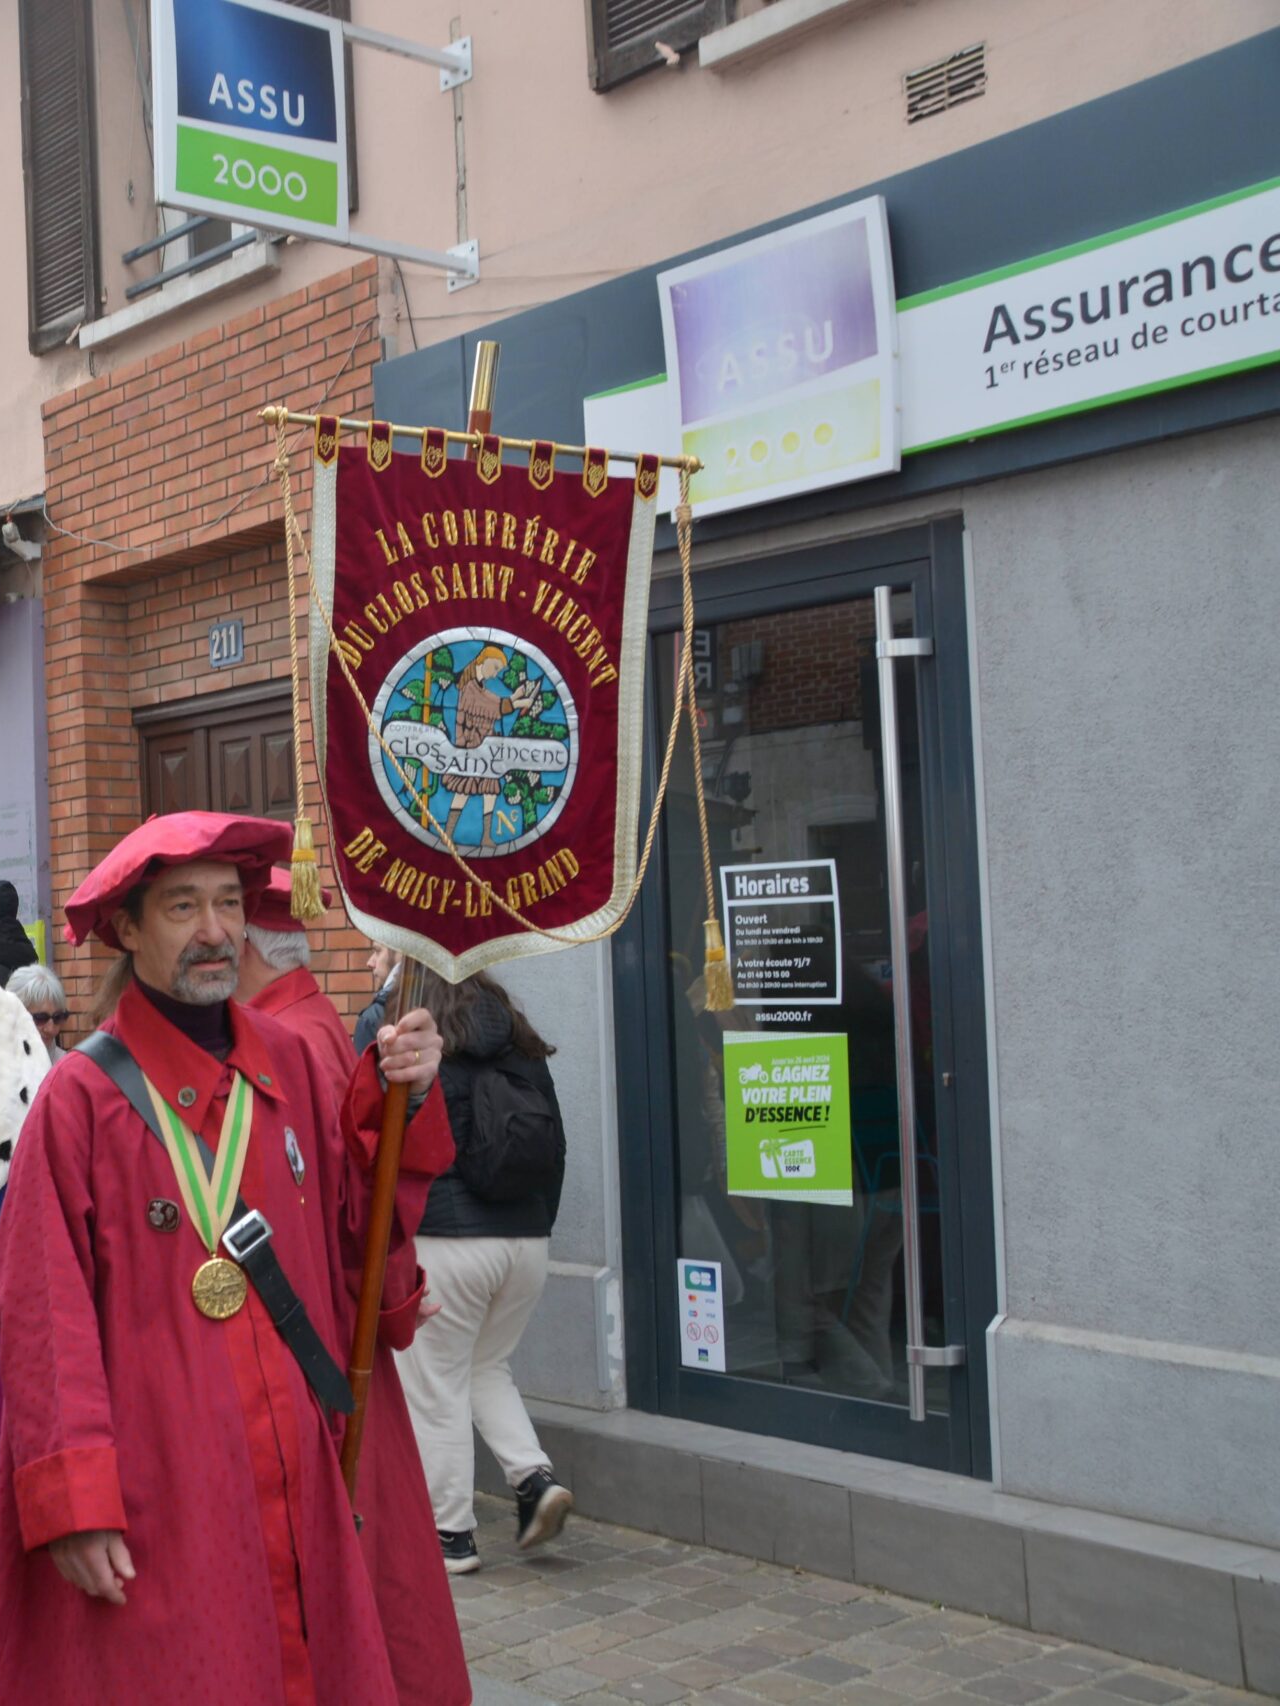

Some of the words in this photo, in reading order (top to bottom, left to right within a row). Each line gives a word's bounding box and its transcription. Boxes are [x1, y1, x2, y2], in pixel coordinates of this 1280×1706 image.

[209, 72, 305, 127] ASSU
[213, 153, 307, 202] 2000
[983, 232, 1280, 353] Assurance
[718, 319, 835, 392] ASSU
[1023, 337, 1120, 379] réseau
[1131, 322, 1168, 350] de
[375, 521, 415, 566] LA
[422, 509, 598, 586] CONFRÉRIE
[336, 620, 375, 670] DU
[364, 572, 430, 634] CLOS
[211, 624, 237, 660] 211
[343, 827, 388, 875] DE
[735, 873, 810, 896] Horaires
[735, 913, 768, 924] Ouvert
[772, 926, 801, 934] vendredi
[744, 959, 764, 968] votre
[765, 958, 793, 967] écoute
[793, 957, 811, 969] 7j/7
[755, 1010, 813, 1022] assu2000.fr
[771, 1064, 830, 1083] GAGNEZ
[742, 1087, 787, 1104] VOTRE
[790, 1085, 832, 1103] PLEIN
[745, 1106, 822, 1123] D'ESSENCE
